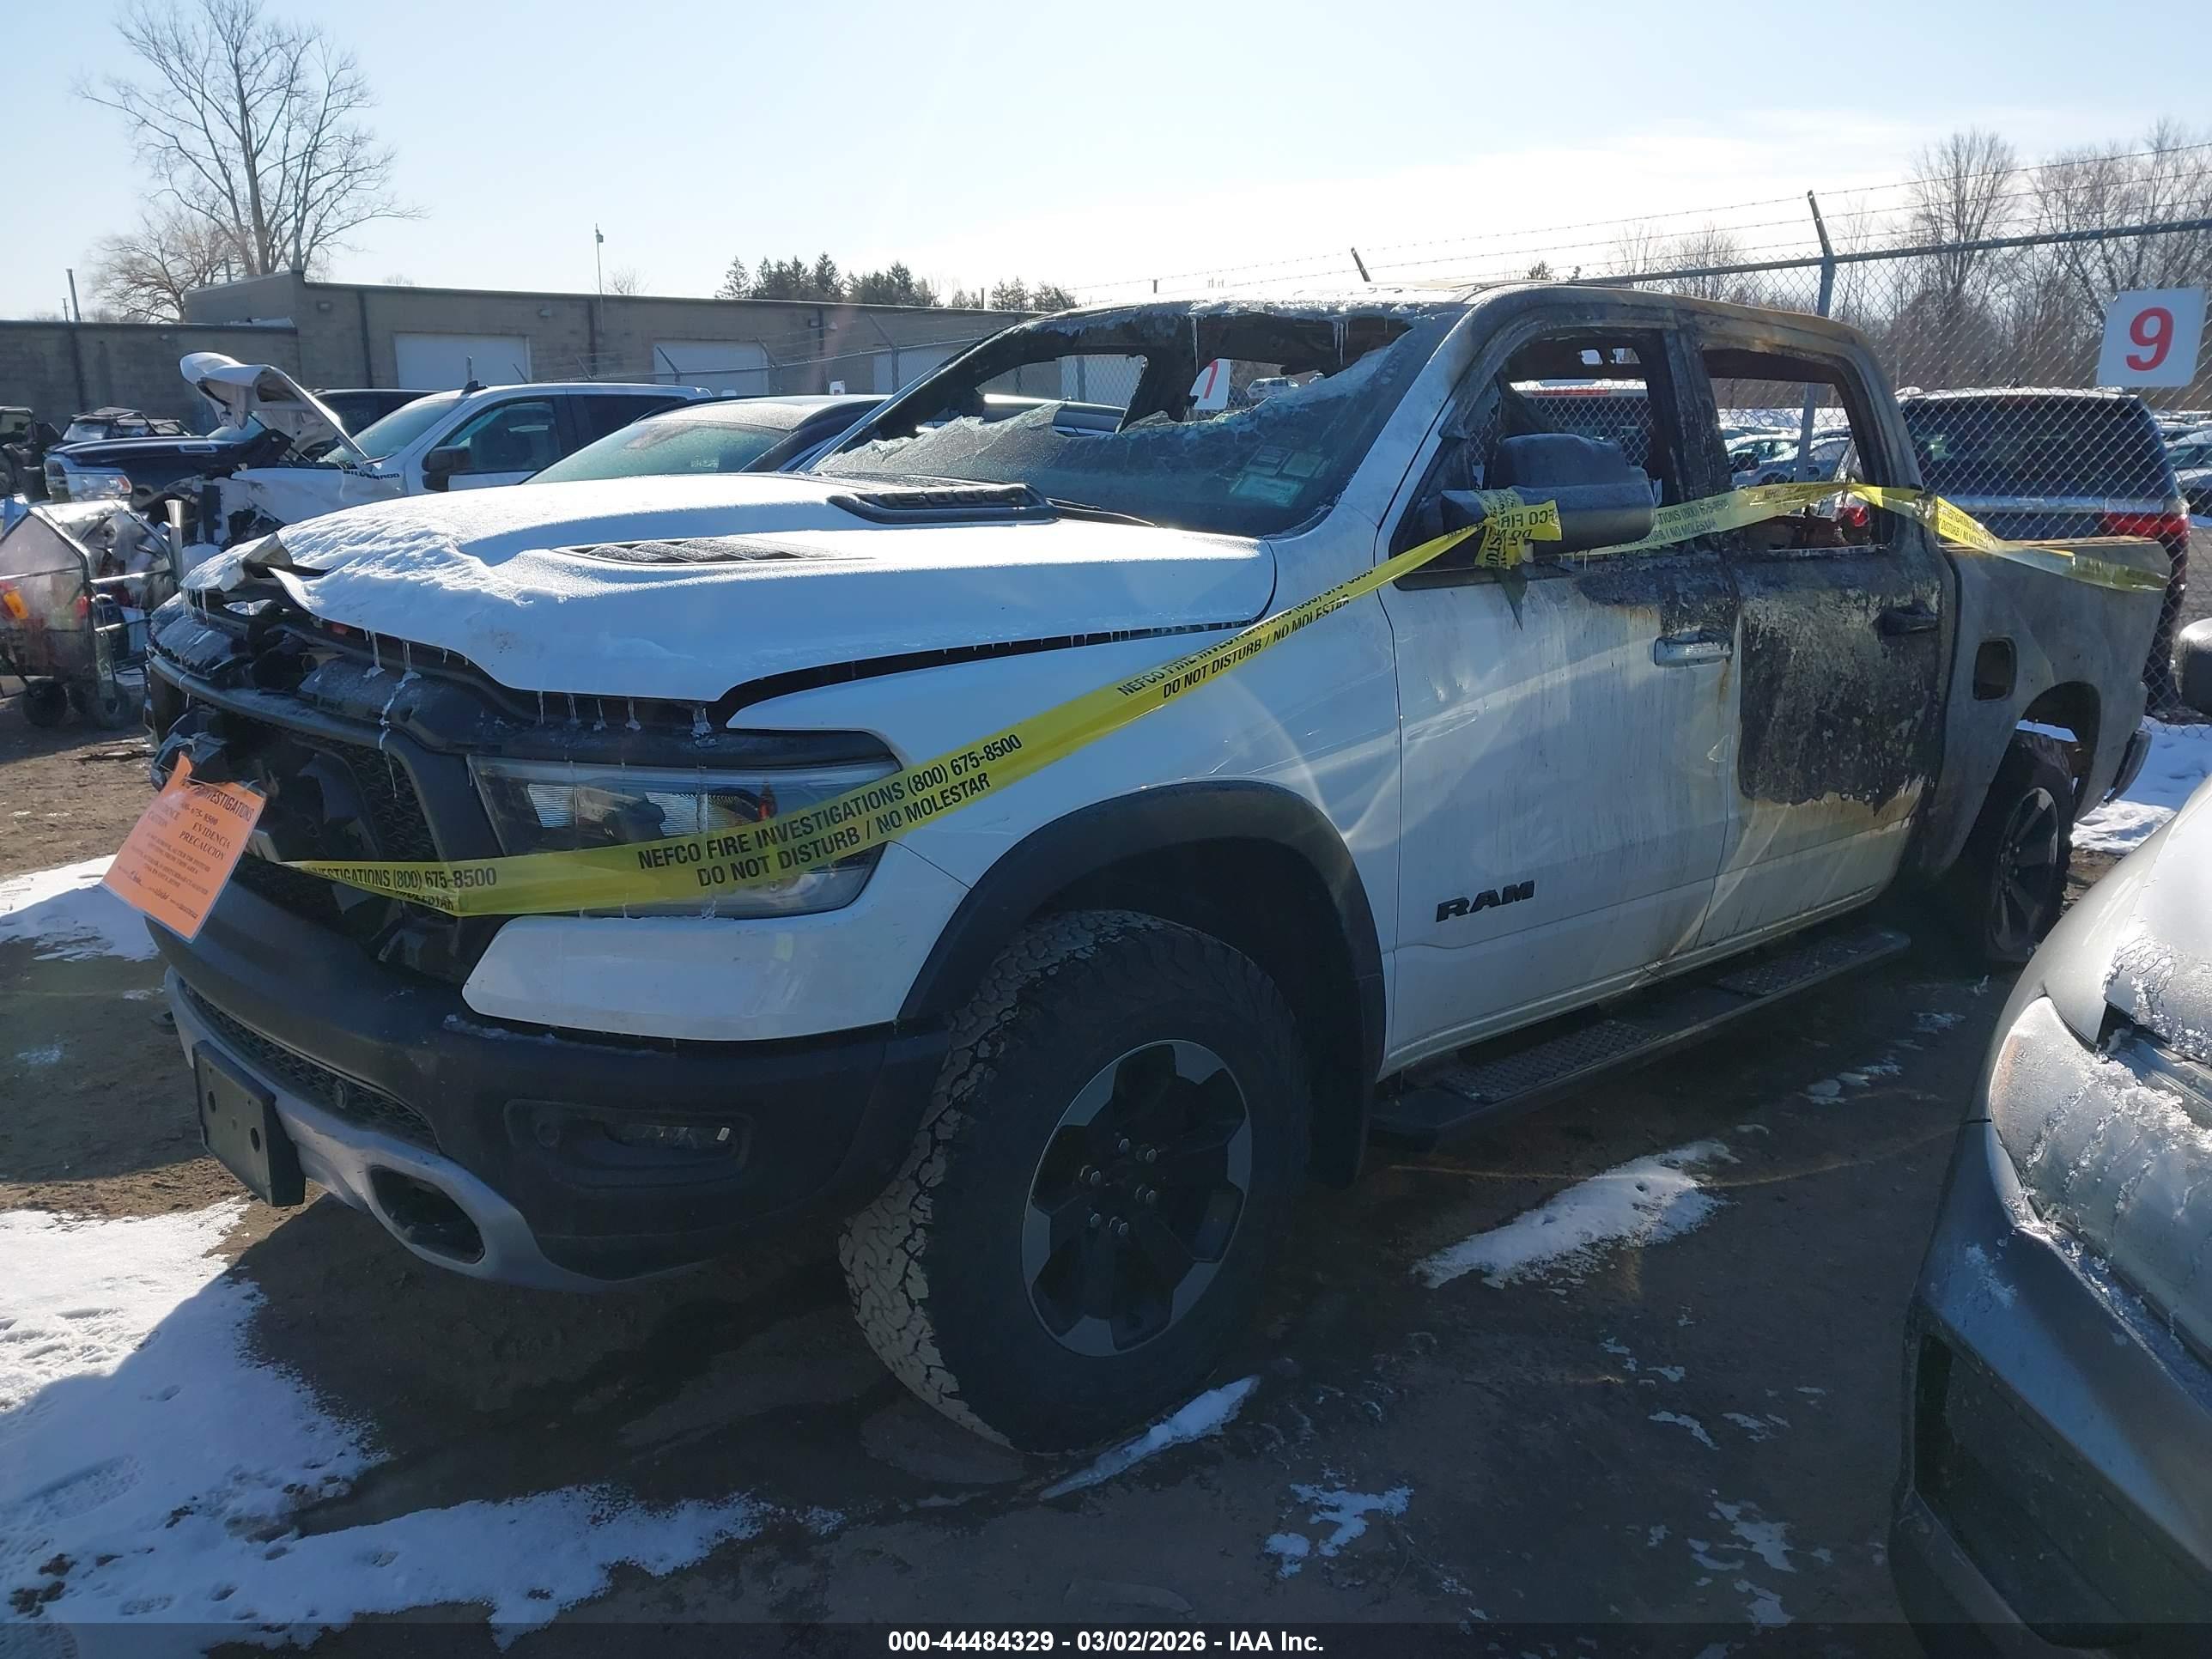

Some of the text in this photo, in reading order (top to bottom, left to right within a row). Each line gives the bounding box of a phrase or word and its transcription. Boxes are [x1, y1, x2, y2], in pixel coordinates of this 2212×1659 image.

[2126, 307, 2174, 371] 9
[1117, 671, 1165, 696] NEFCO
[1164, 678, 1181, 699] DO
[1184, 665, 1208, 688] NOT
[1212, 638, 1262, 674] DISTURB
[1273, 625, 1289, 642] NO
[637, 734, 1023, 869] NEFCO FIRE INVESTIGATIONS (800) 675-8500
[191, 822, 231, 850] EVIDENCIA
[696, 865, 726, 887] DO
[732, 854, 770, 881] NOT
[777, 827, 860, 869] DISTURB
[875, 810, 902, 835] NO
[904, 772, 991, 823] MOLESTAR
[393, 871, 422, 890] (800)
[425, 867, 497, 889] 675-8500
[1436, 879, 1535, 923] RAM
